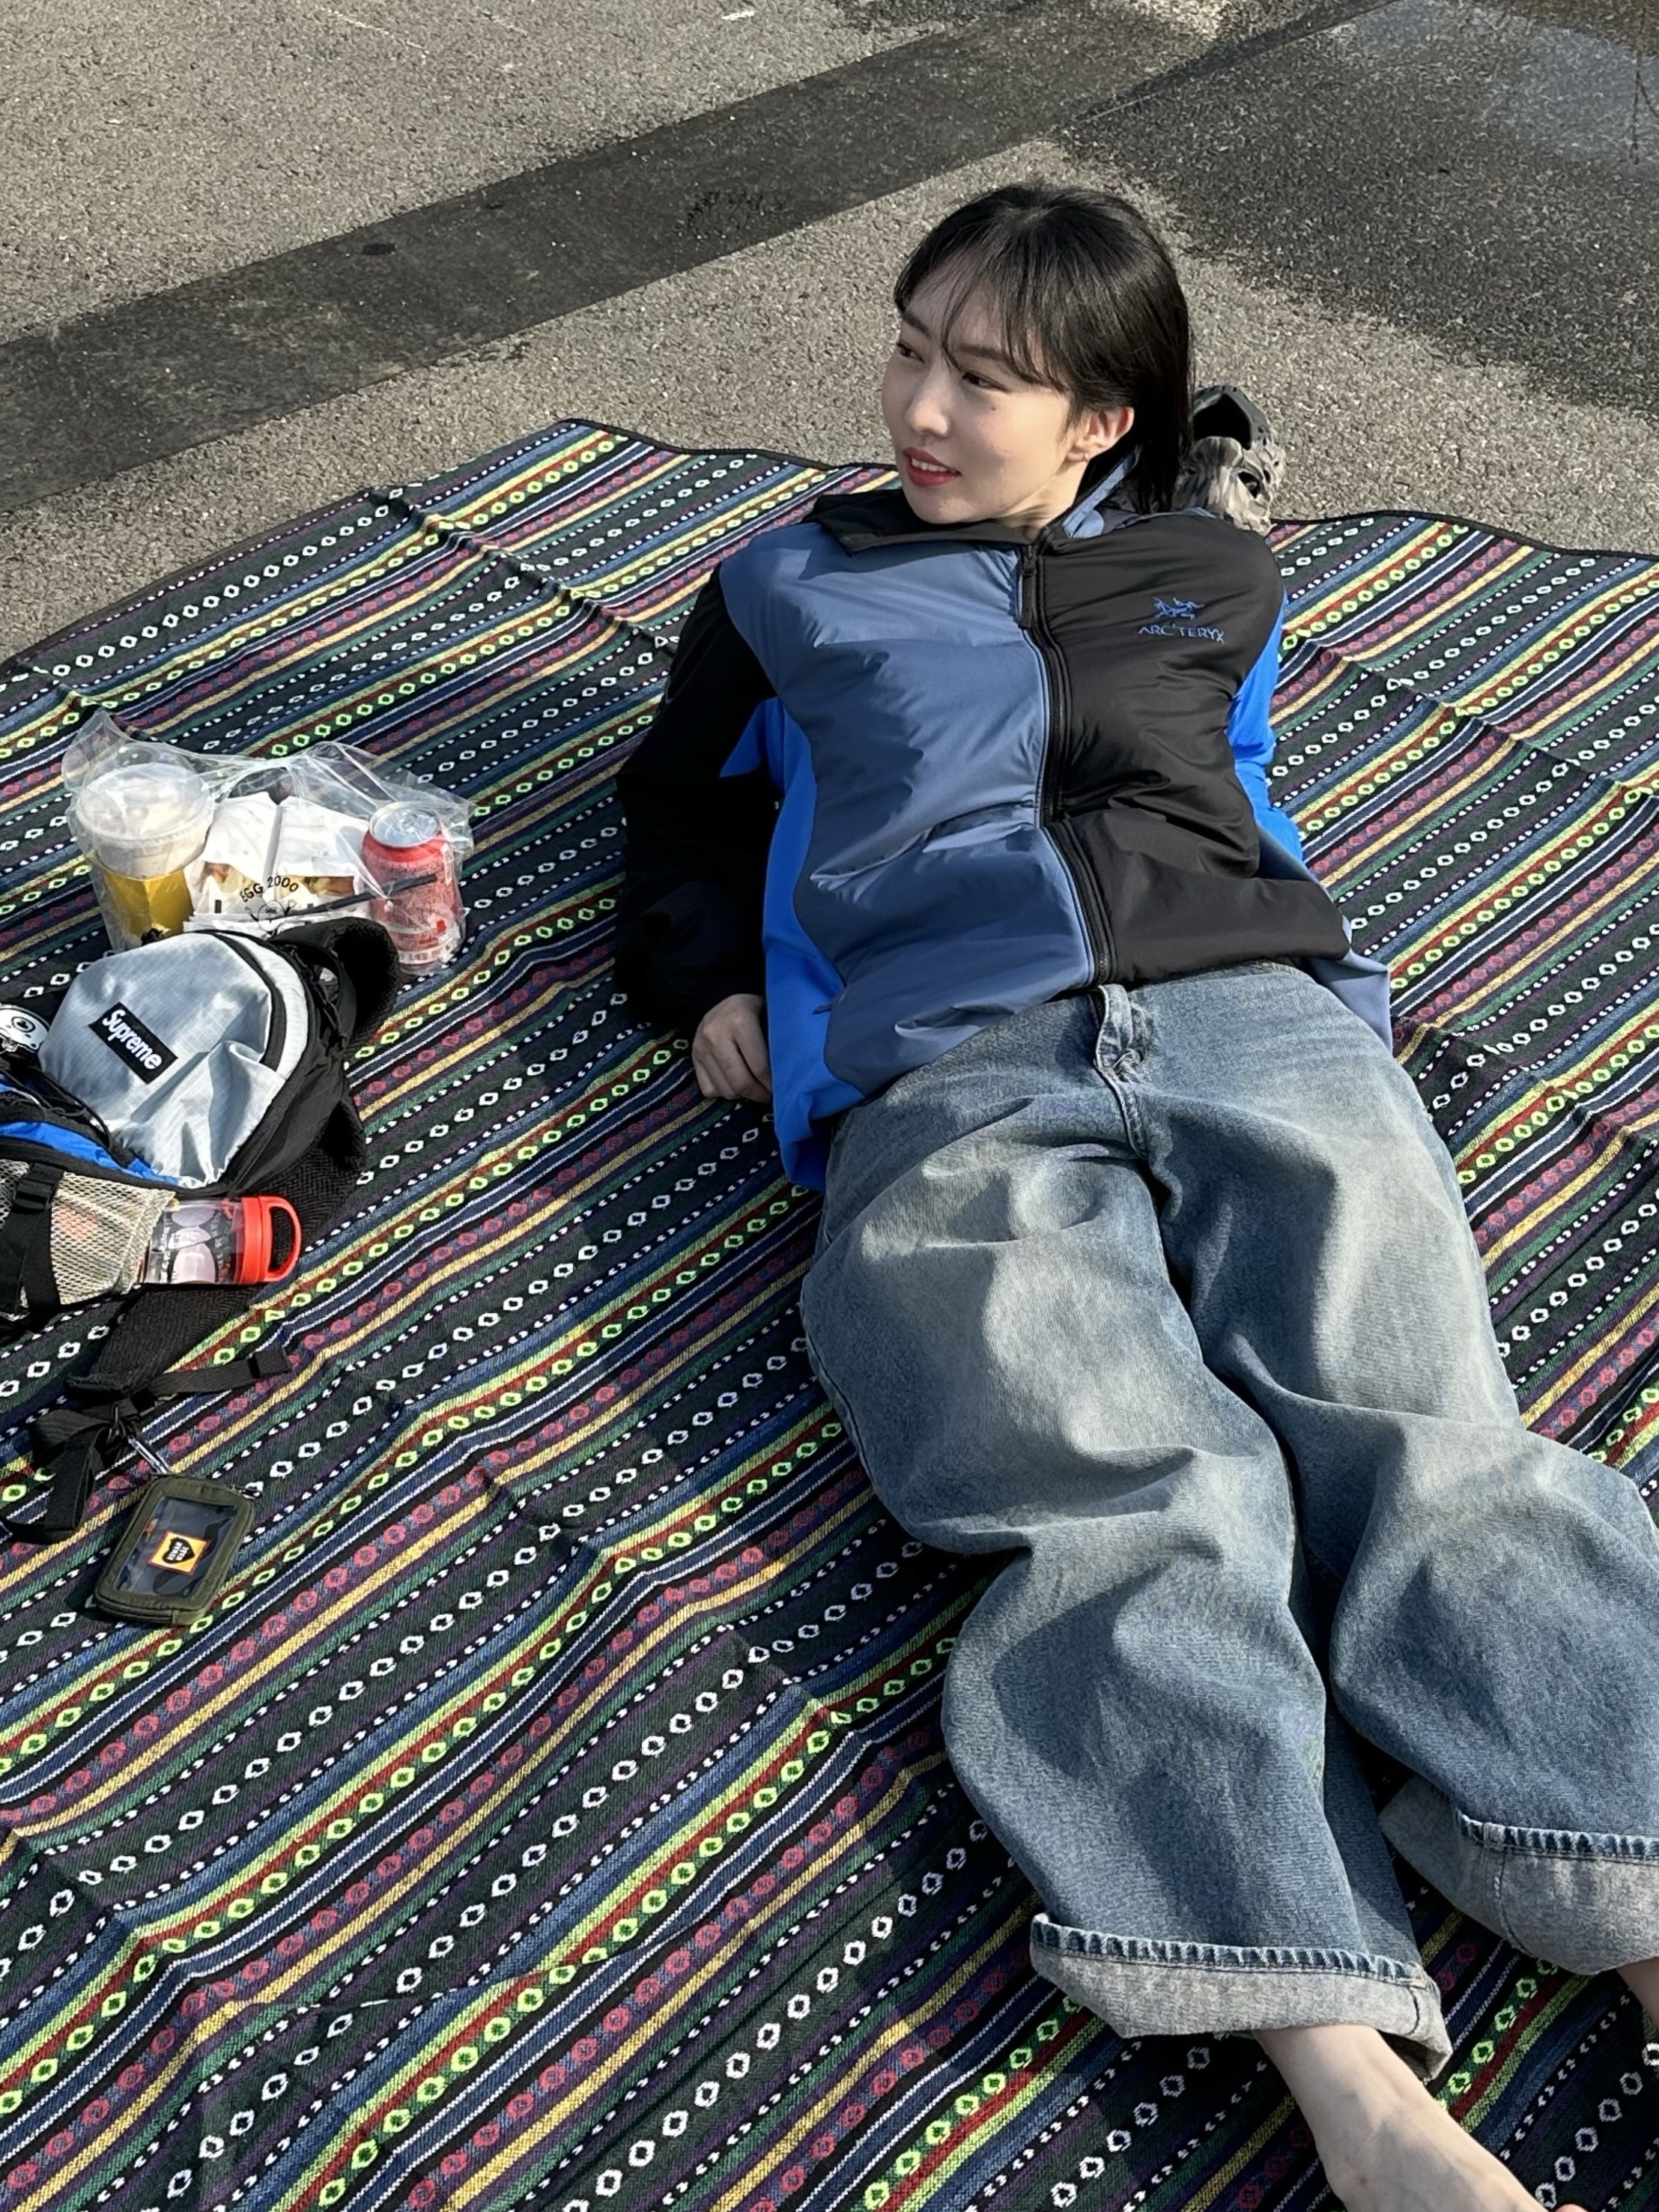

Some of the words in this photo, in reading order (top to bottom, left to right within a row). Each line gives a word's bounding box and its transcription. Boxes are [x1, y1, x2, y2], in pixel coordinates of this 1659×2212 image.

[240, 882, 264, 903] EGG
[267, 875, 299, 892] 2000
[102, 1009, 163, 1070] Supreme
